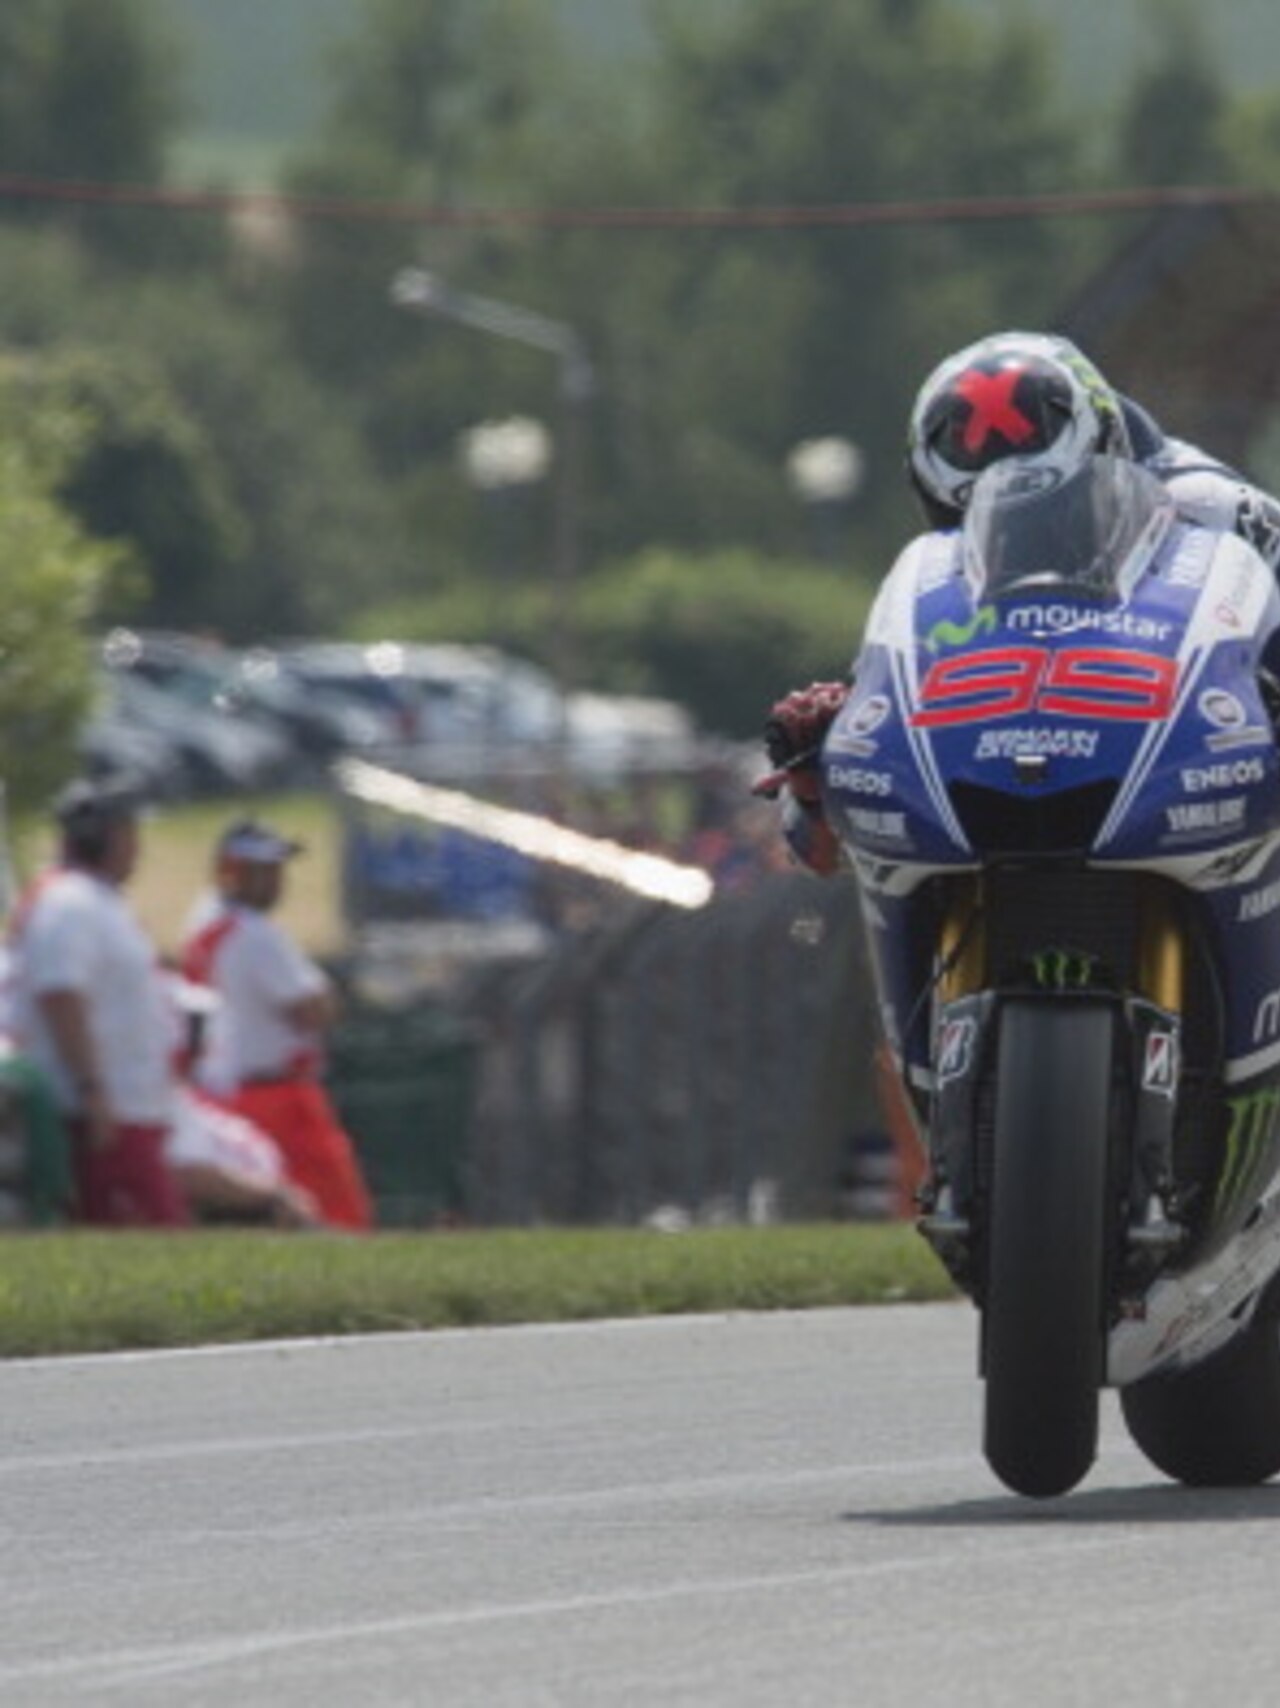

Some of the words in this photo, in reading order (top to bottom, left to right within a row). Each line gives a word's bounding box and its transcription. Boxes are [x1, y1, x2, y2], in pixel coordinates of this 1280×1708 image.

[1007, 604, 1172, 640] movistar
[908, 646, 1180, 728] 99
[828, 765, 893, 797] ENEOS
[1180, 757, 1265, 793] ENEOS
